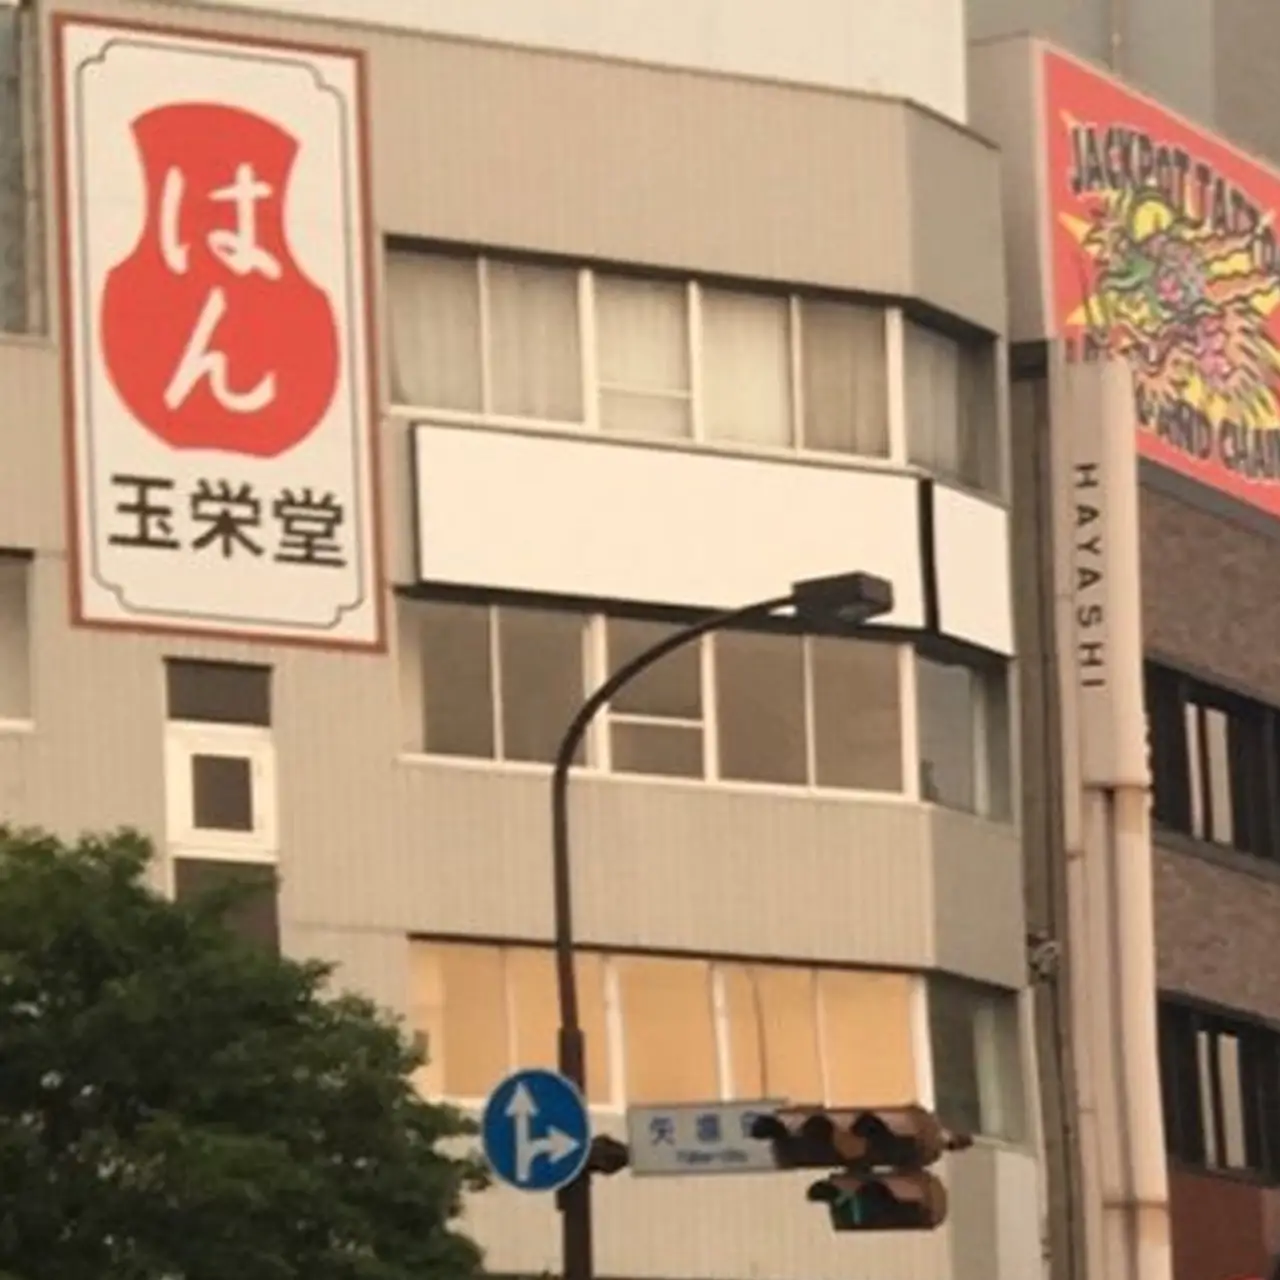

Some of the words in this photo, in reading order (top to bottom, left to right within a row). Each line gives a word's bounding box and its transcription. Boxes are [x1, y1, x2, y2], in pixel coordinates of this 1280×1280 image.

[1069, 125, 1192, 212] JACKPOT
[159, 163, 282, 413] はん
[107, 473, 348, 568] 玉栄堂
[1074, 461, 1106, 689] HAYASHI
